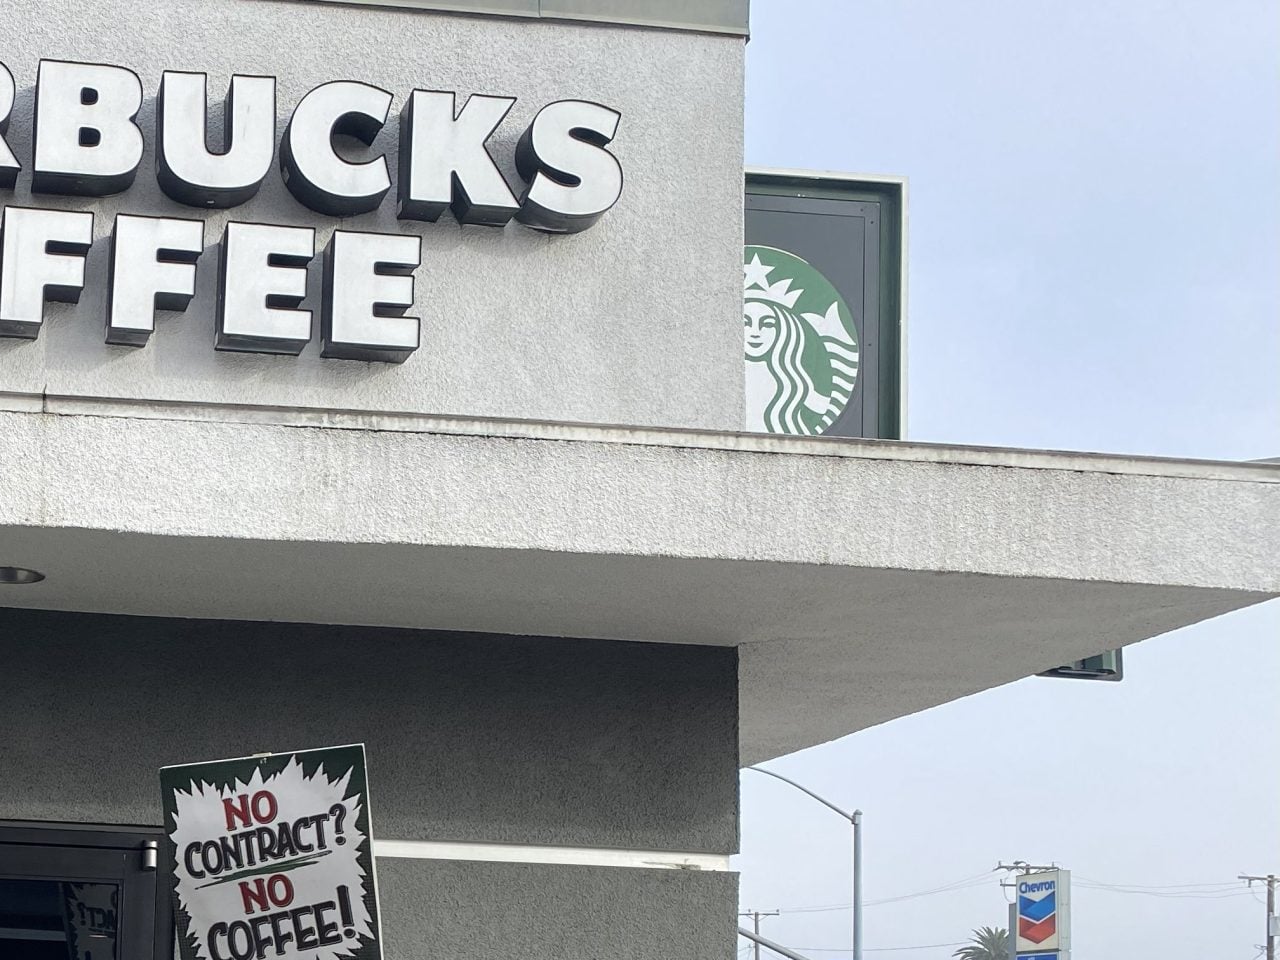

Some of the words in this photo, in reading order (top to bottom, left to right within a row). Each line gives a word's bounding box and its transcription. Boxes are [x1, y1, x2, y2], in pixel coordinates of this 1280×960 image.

[222, 790, 278, 832] NO
[185, 803, 346, 879] CONTRACT?
[239, 873, 294, 914] NO
[1019, 881, 1055, 894] Chevron
